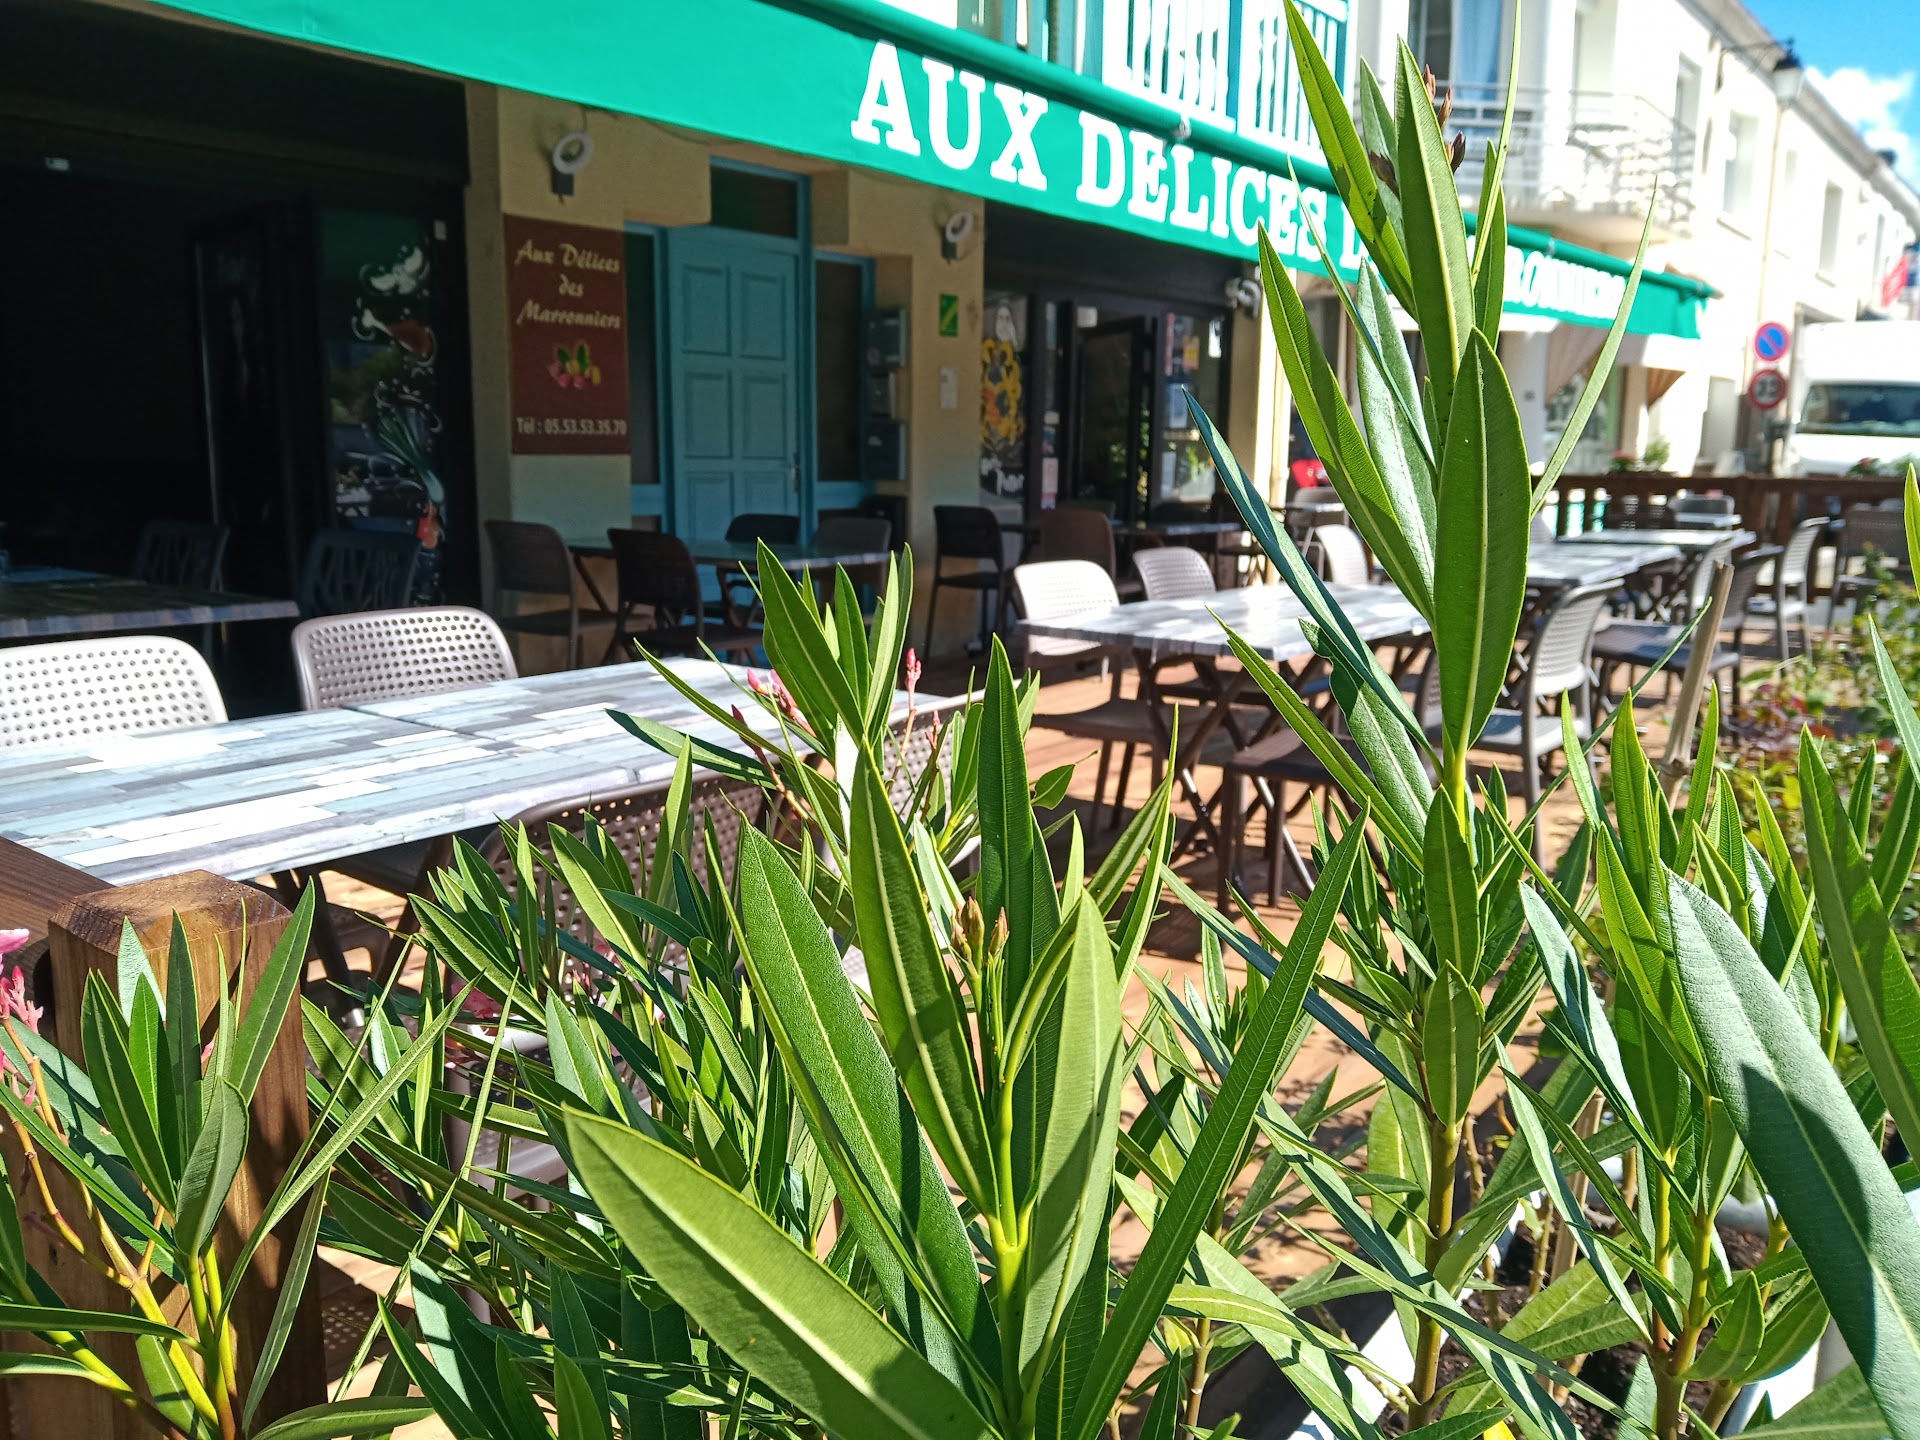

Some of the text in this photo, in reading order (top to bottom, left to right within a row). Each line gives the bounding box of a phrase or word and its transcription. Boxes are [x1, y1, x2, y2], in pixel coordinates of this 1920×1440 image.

[850, 40, 1048, 191] AUX
[1076, 110, 1328, 262] DELICES
[515, 239, 620, 273] Aux Délices
[559, 274, 584, 297] des
[516, 300, 620, 328] Marronniers
